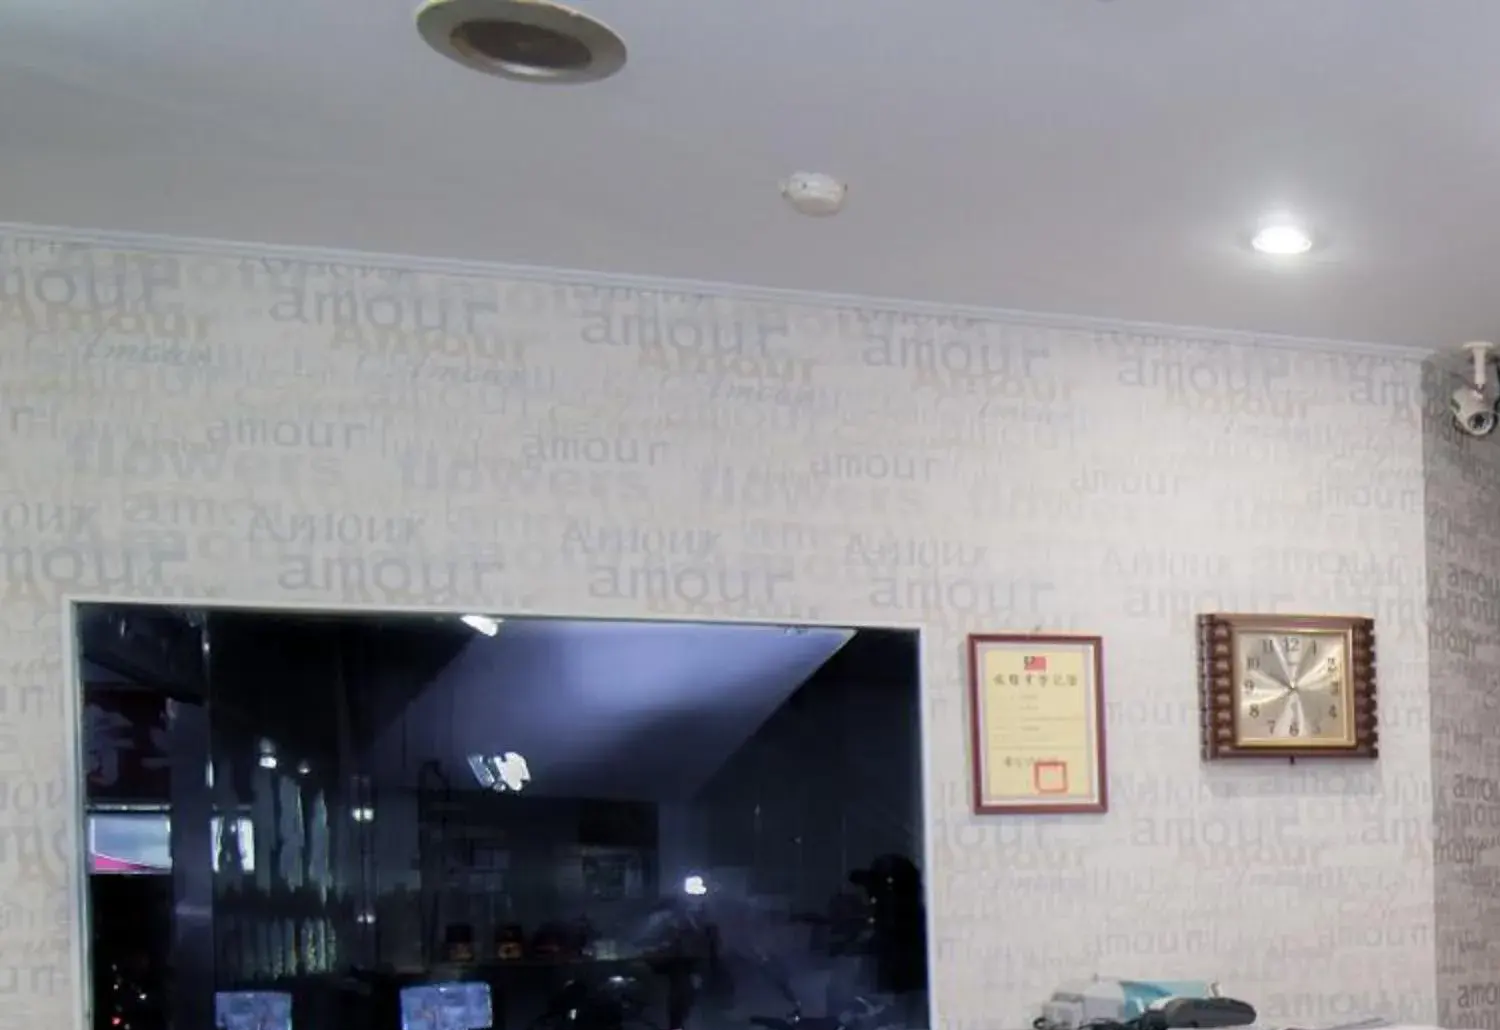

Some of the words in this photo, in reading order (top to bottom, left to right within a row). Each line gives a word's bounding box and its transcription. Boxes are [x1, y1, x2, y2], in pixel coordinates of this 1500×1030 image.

[268, 284, 498, 332] amour
[581, 308, 787, 357] amour
[862, 332, 1049, 378] amour
[1117, 355, 1290, 396] amour
[206, 417, 367, 450] amour
[522, 433, 671, 467] amour
[810, 452, 941, 482] amour
[277, 553, 505, 595] amour
[589, 563, 793, 606] amour
[870, 574, 1055, 614] amour
[1285, 635, 1300, 652] 12
[1249, 703, 1260, 719] 8
[1267, 719, 1276, 735] 7
[1289, 721, 1299, 737] 6
[1131, 815, 1299, 847] amour
